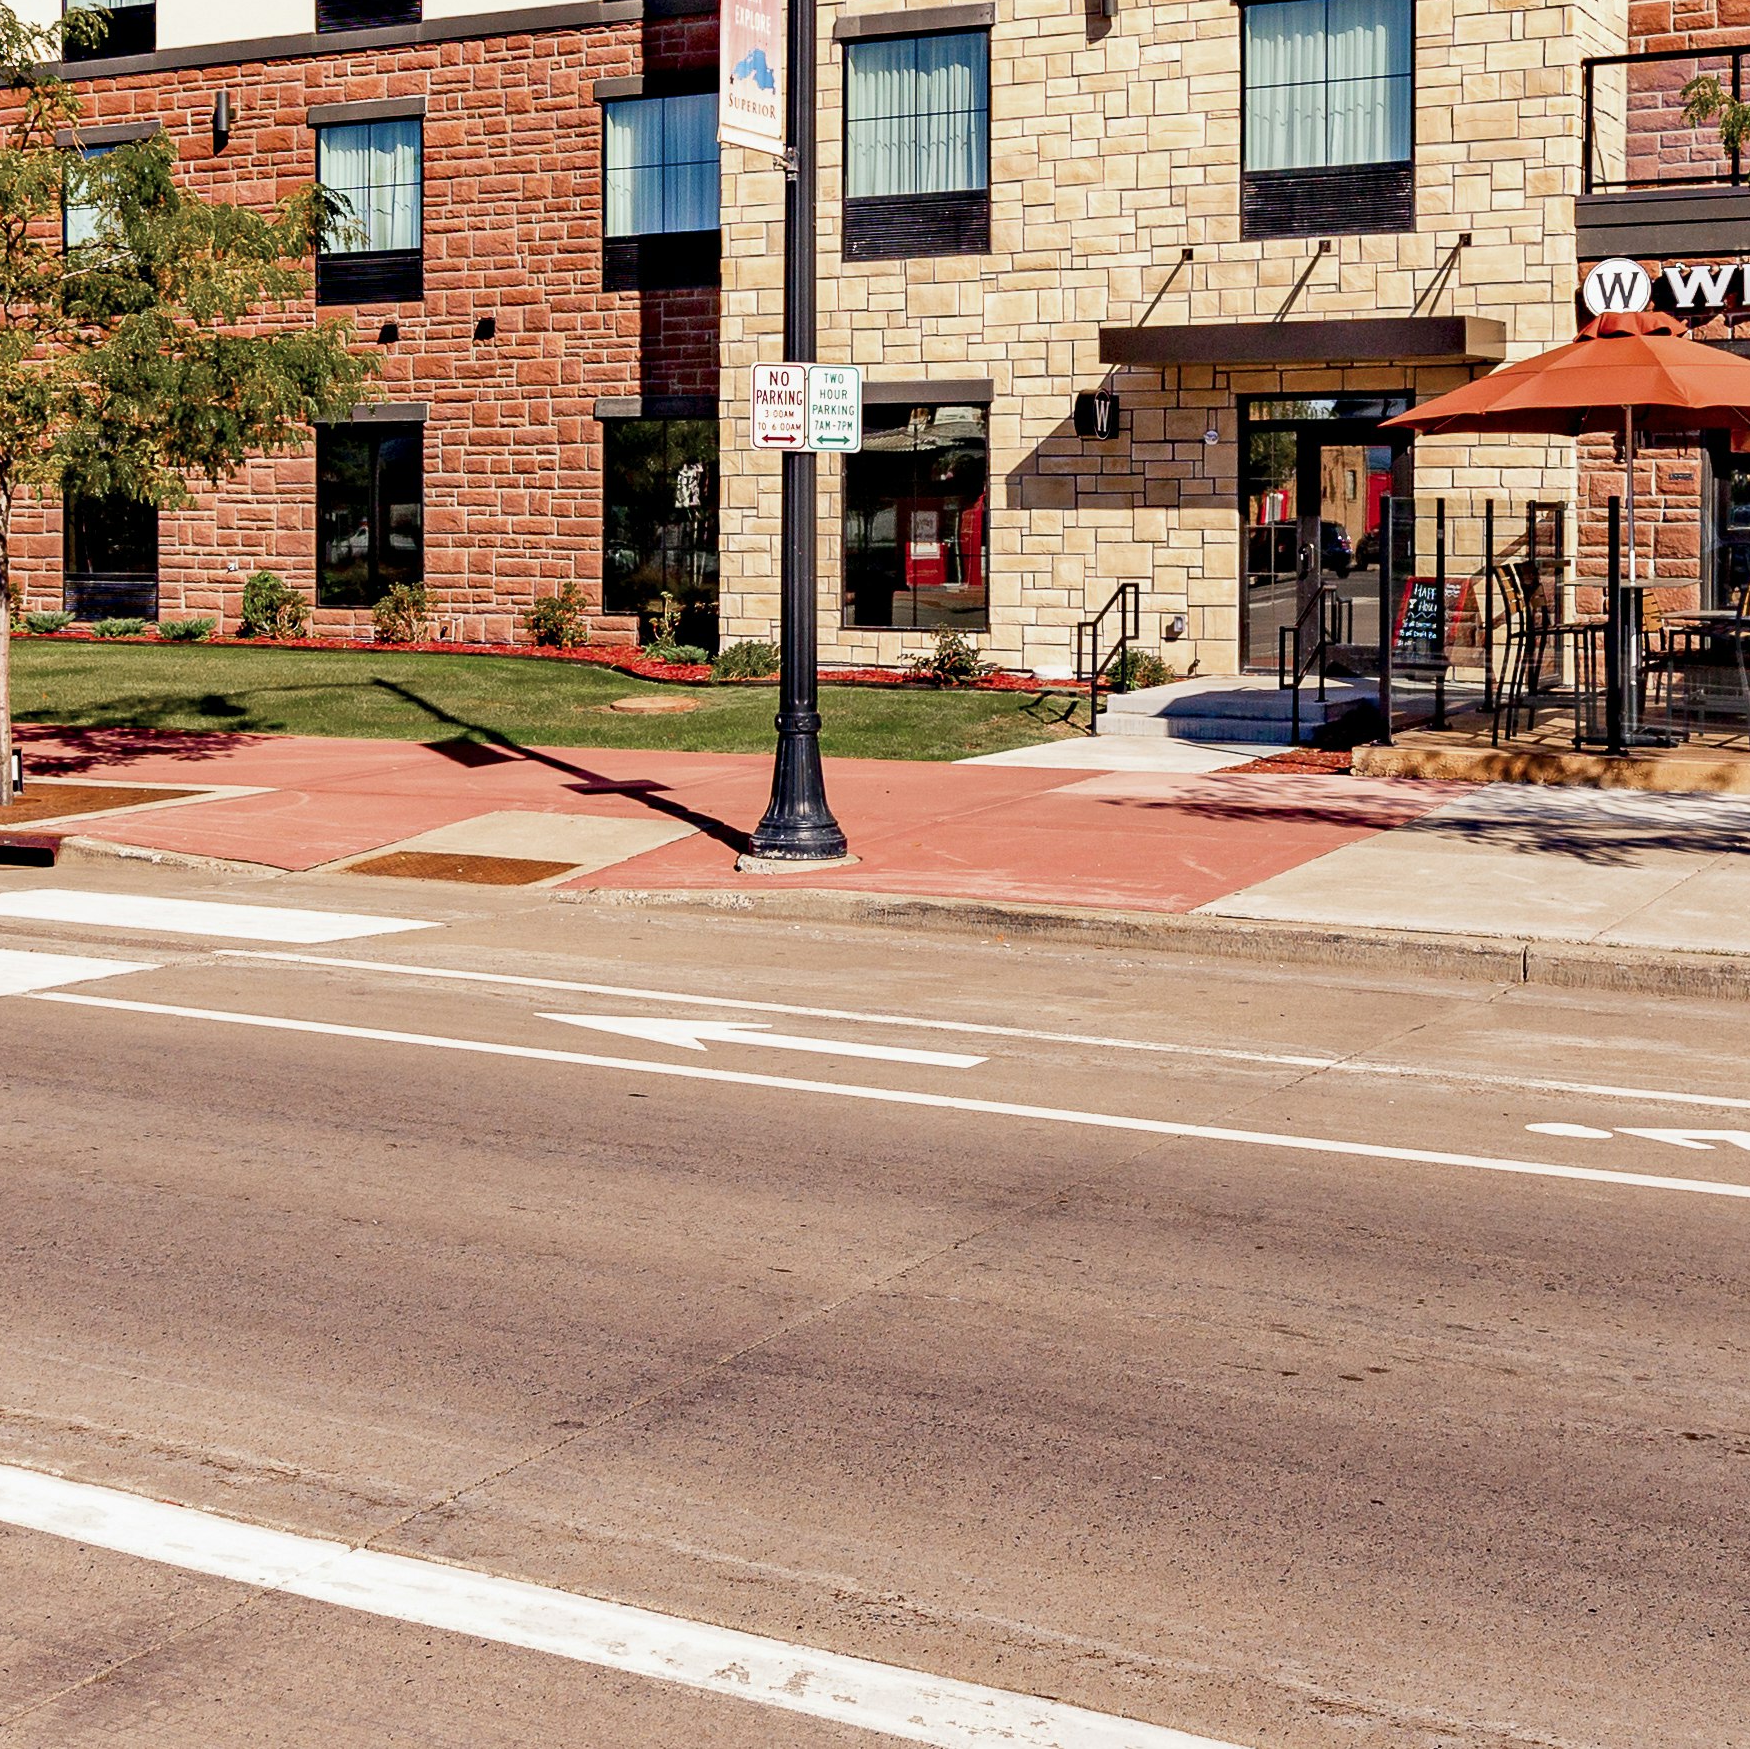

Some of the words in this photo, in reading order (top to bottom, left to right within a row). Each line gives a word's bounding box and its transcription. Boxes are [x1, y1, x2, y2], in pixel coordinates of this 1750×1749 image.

[734, 4, 771, 34] EXPLORE
[729, 92, 776, 120] SUPERIOR
[769, 371, 790, 387] NO
[824, 373, 844, 384] TWO
[756, 389, 803, 406] PARKING
[819, 389, 848, 400] HOUR
[812, 404, 855, 416] PARKING
[758, 422, 767, 431] TO
